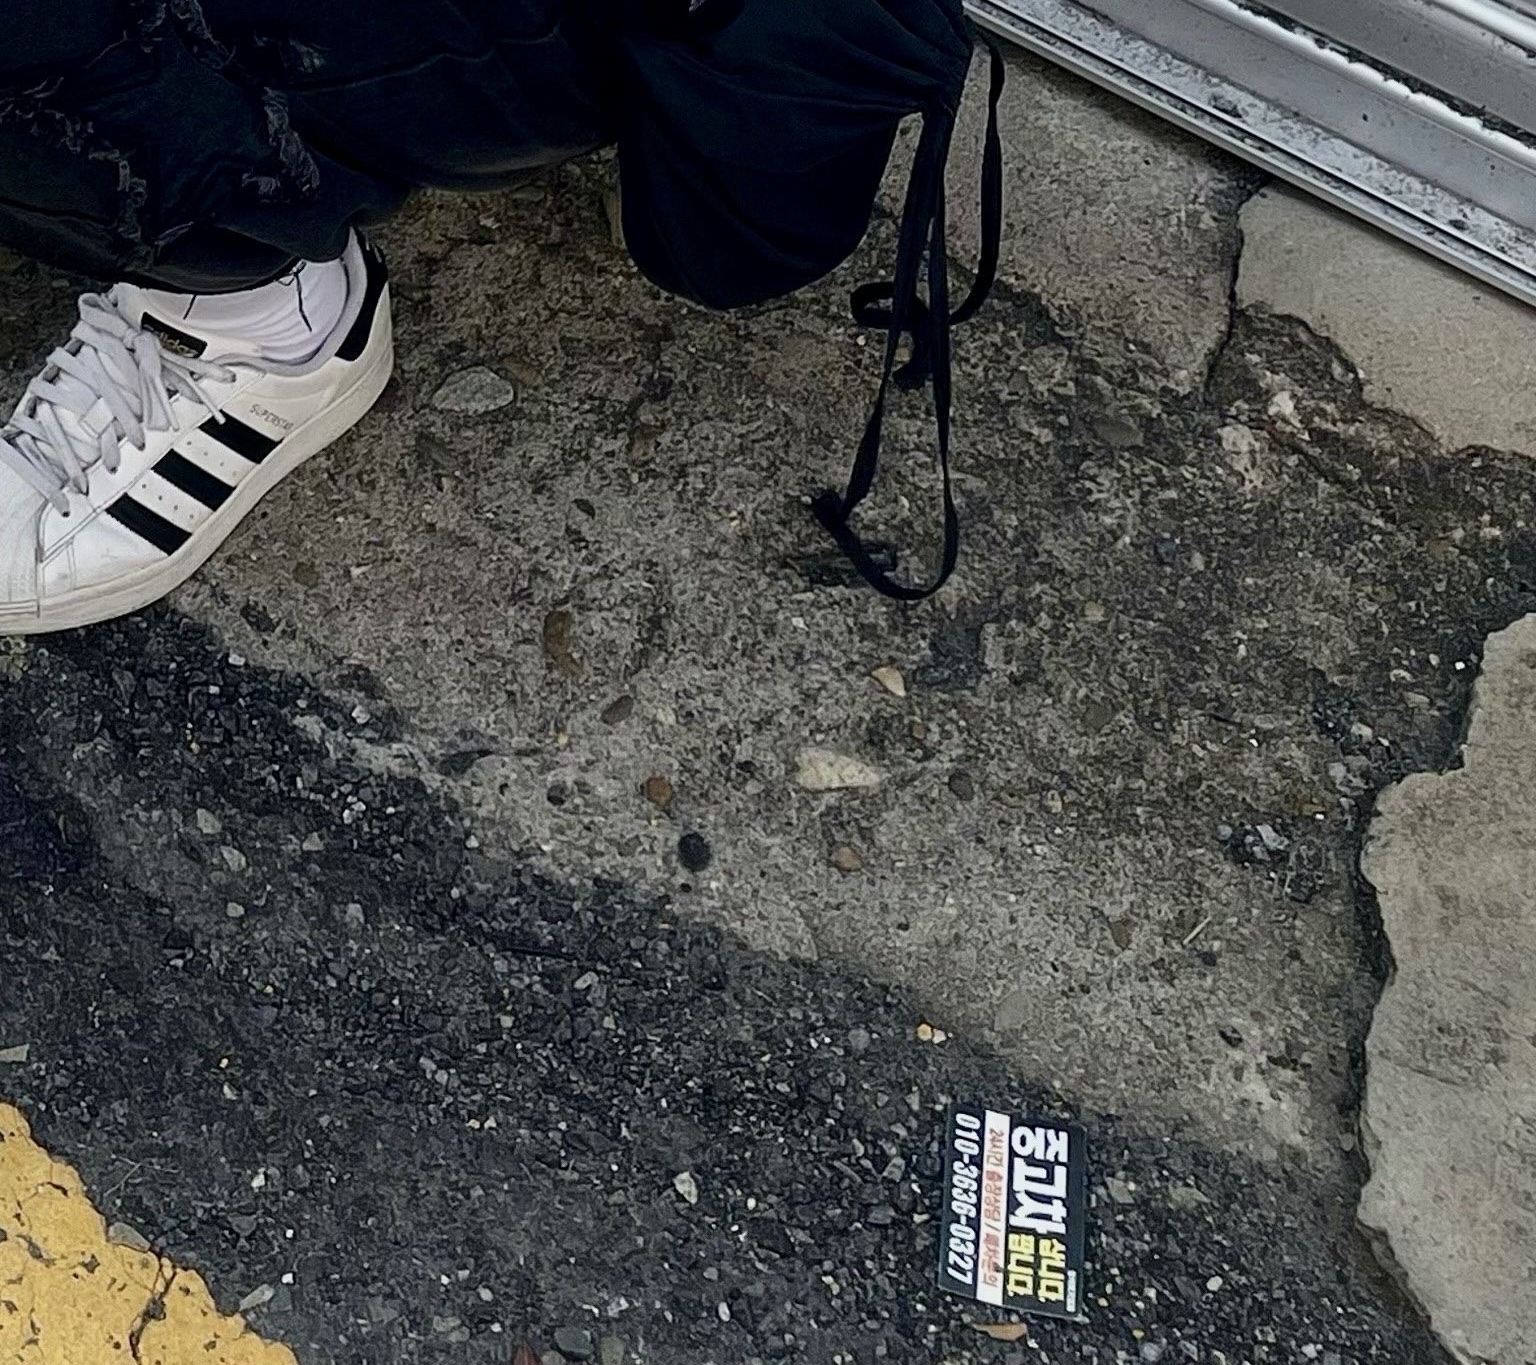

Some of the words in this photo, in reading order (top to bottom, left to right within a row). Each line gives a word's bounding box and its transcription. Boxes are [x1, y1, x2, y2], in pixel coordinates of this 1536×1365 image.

[143, 323, 199, 357] didas
[986, 1128, 1005, 1167] 24시간
[947, 1112, 981, 1285] 010-3636-0327
[983, 1169, 1004, 1220] 출장상담
[1009, 1126, 1068, 1235] 중고차
